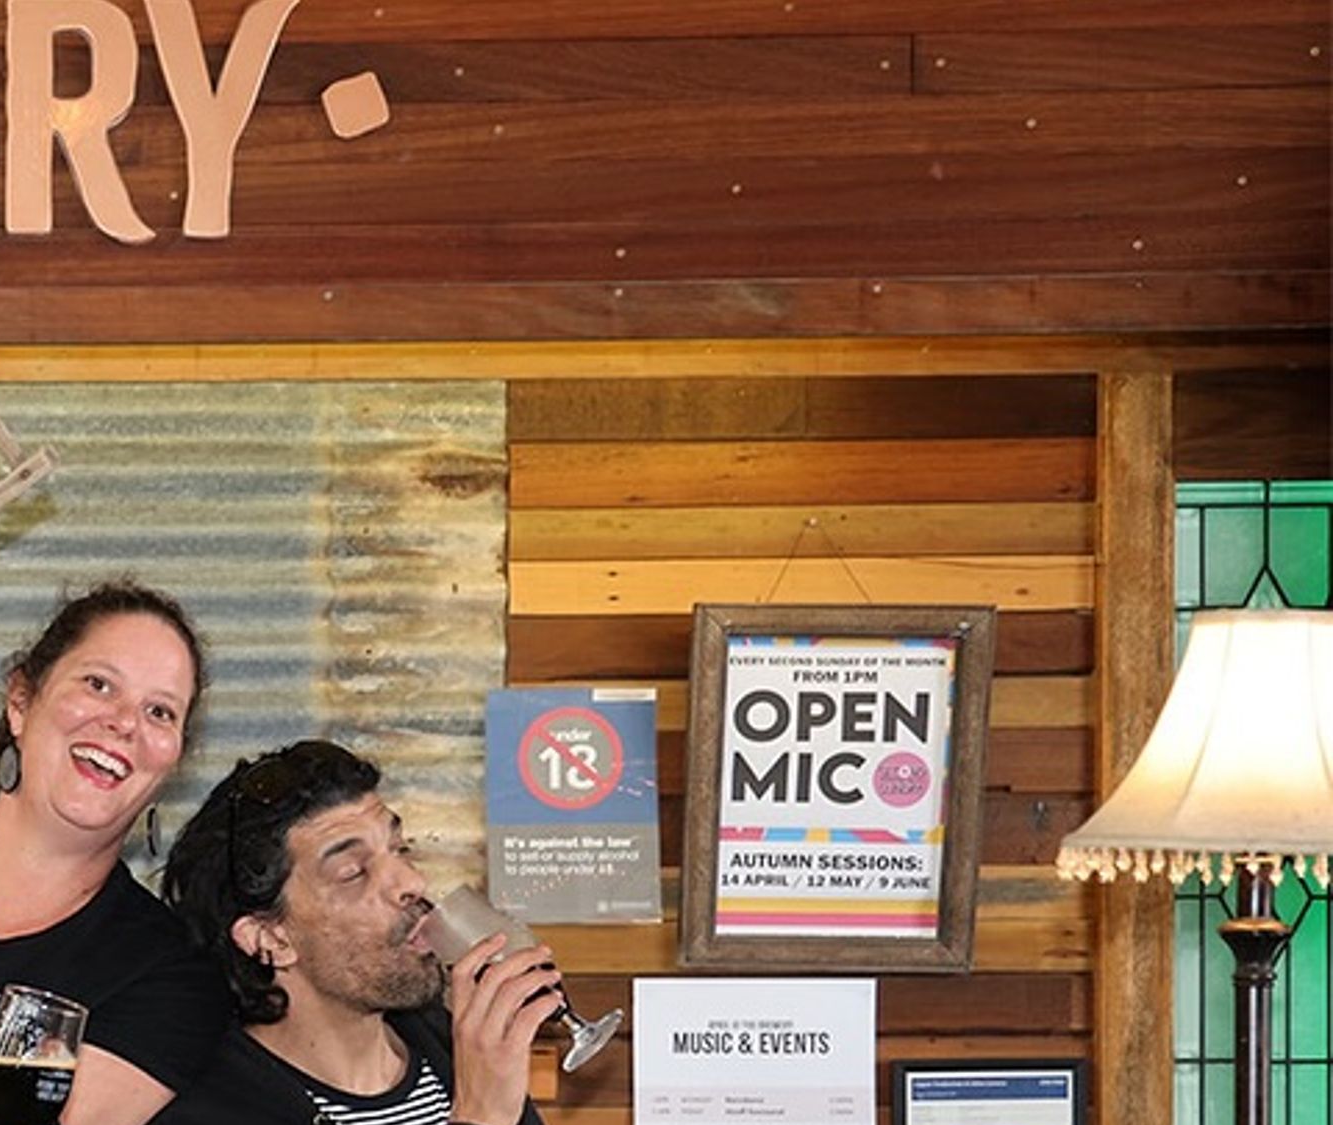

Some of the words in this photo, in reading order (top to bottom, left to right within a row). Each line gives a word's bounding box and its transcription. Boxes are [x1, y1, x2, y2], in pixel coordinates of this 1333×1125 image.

[793, 671, 839, 683] FROM
[843, 671, 878, 683] 1PM
[733, 689, 930, 744] OPEN
[539, 744, 598, 790] 18
[730, 752, 866, 804] MIC
[529, 836, 578, 851] against
[582, 836, 603, 848] the
[730, 853, 812, 869] AUTUMN
[818, 855, 923, 871] SESSIONS:
[721, 875, 739, 887] 14
[744, 874, 790, 887] APRIL
[807, 876, 825, 888] 12
[829, 876, 861, 888] MAY
[879, 877, 888, 889] 9
[891, 878, 931, 889] JUNE
[673, 1032, 734, 1054] MUSIC
[738, 1032, 753, 1054] &
[759, 1032, 831, 1054] EVENTS
